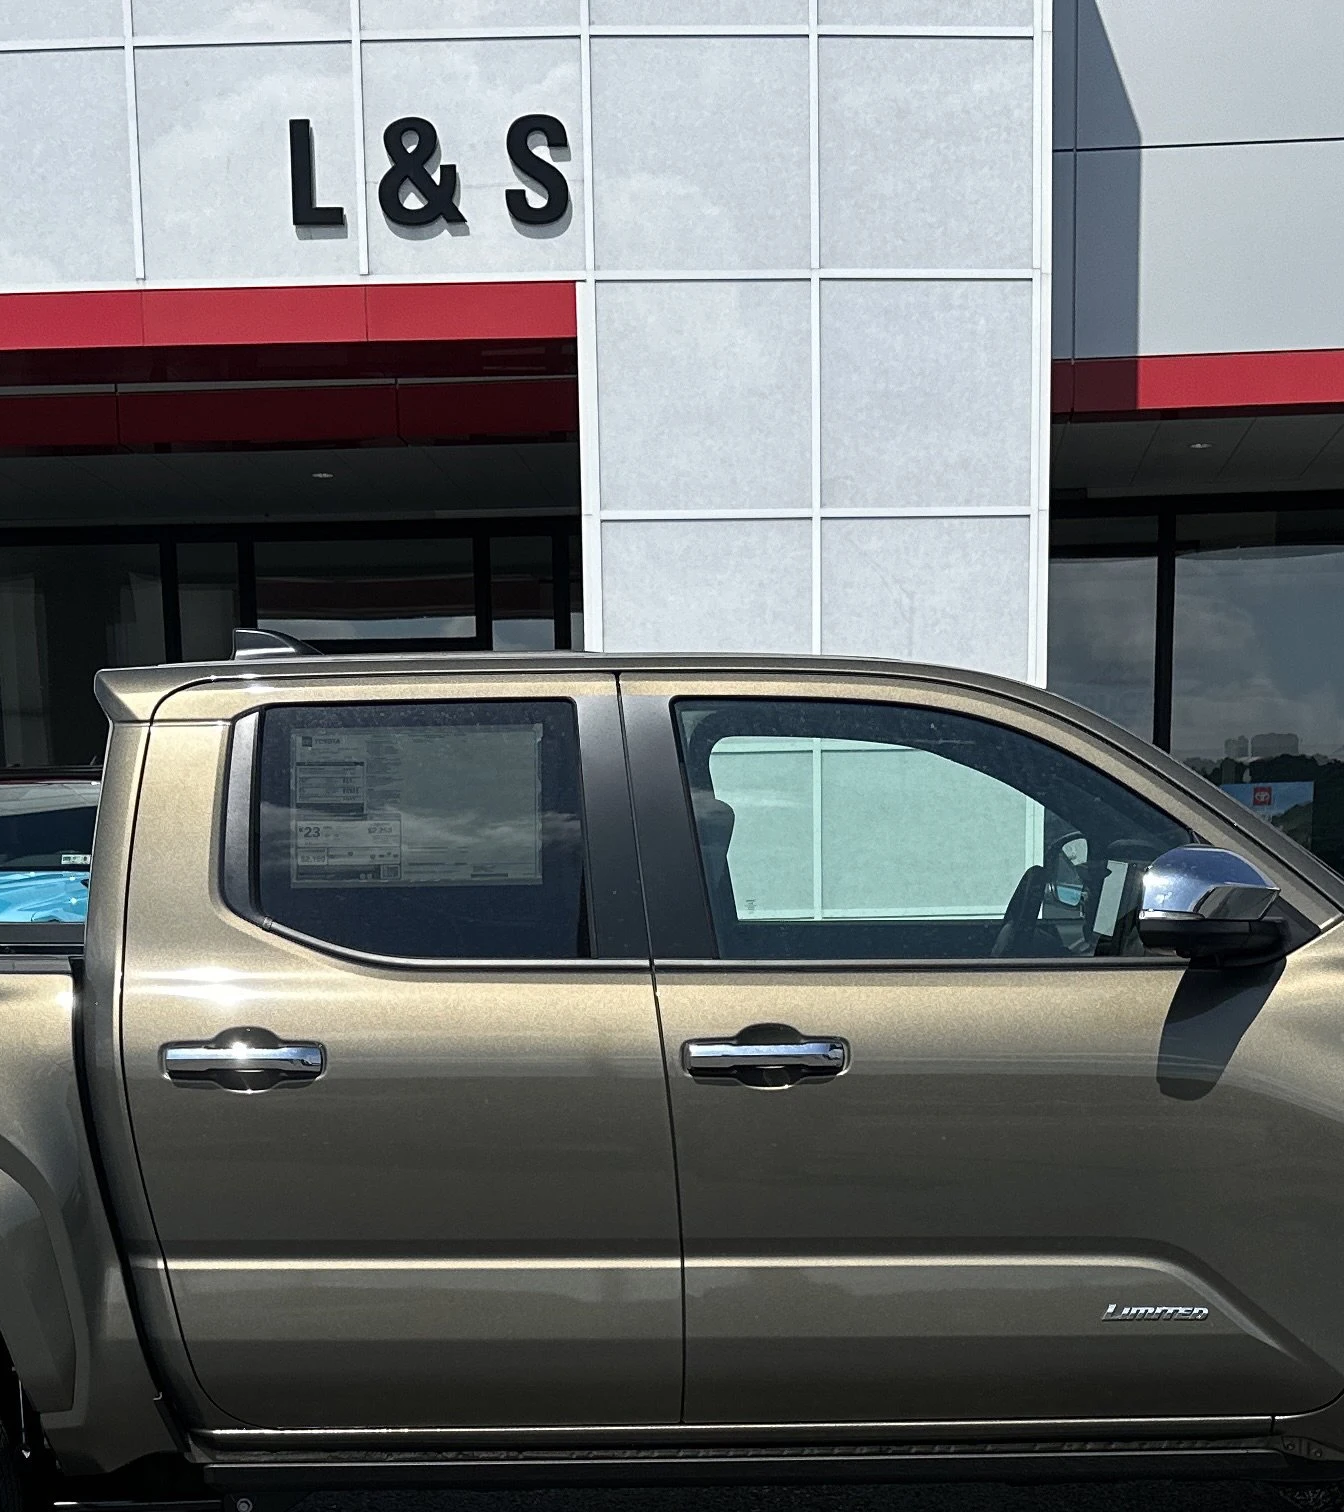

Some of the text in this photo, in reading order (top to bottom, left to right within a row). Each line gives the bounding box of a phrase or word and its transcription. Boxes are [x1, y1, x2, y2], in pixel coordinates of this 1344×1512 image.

[289, 113, 569, 226] L & S
[303, 826, 321, 838] 23
